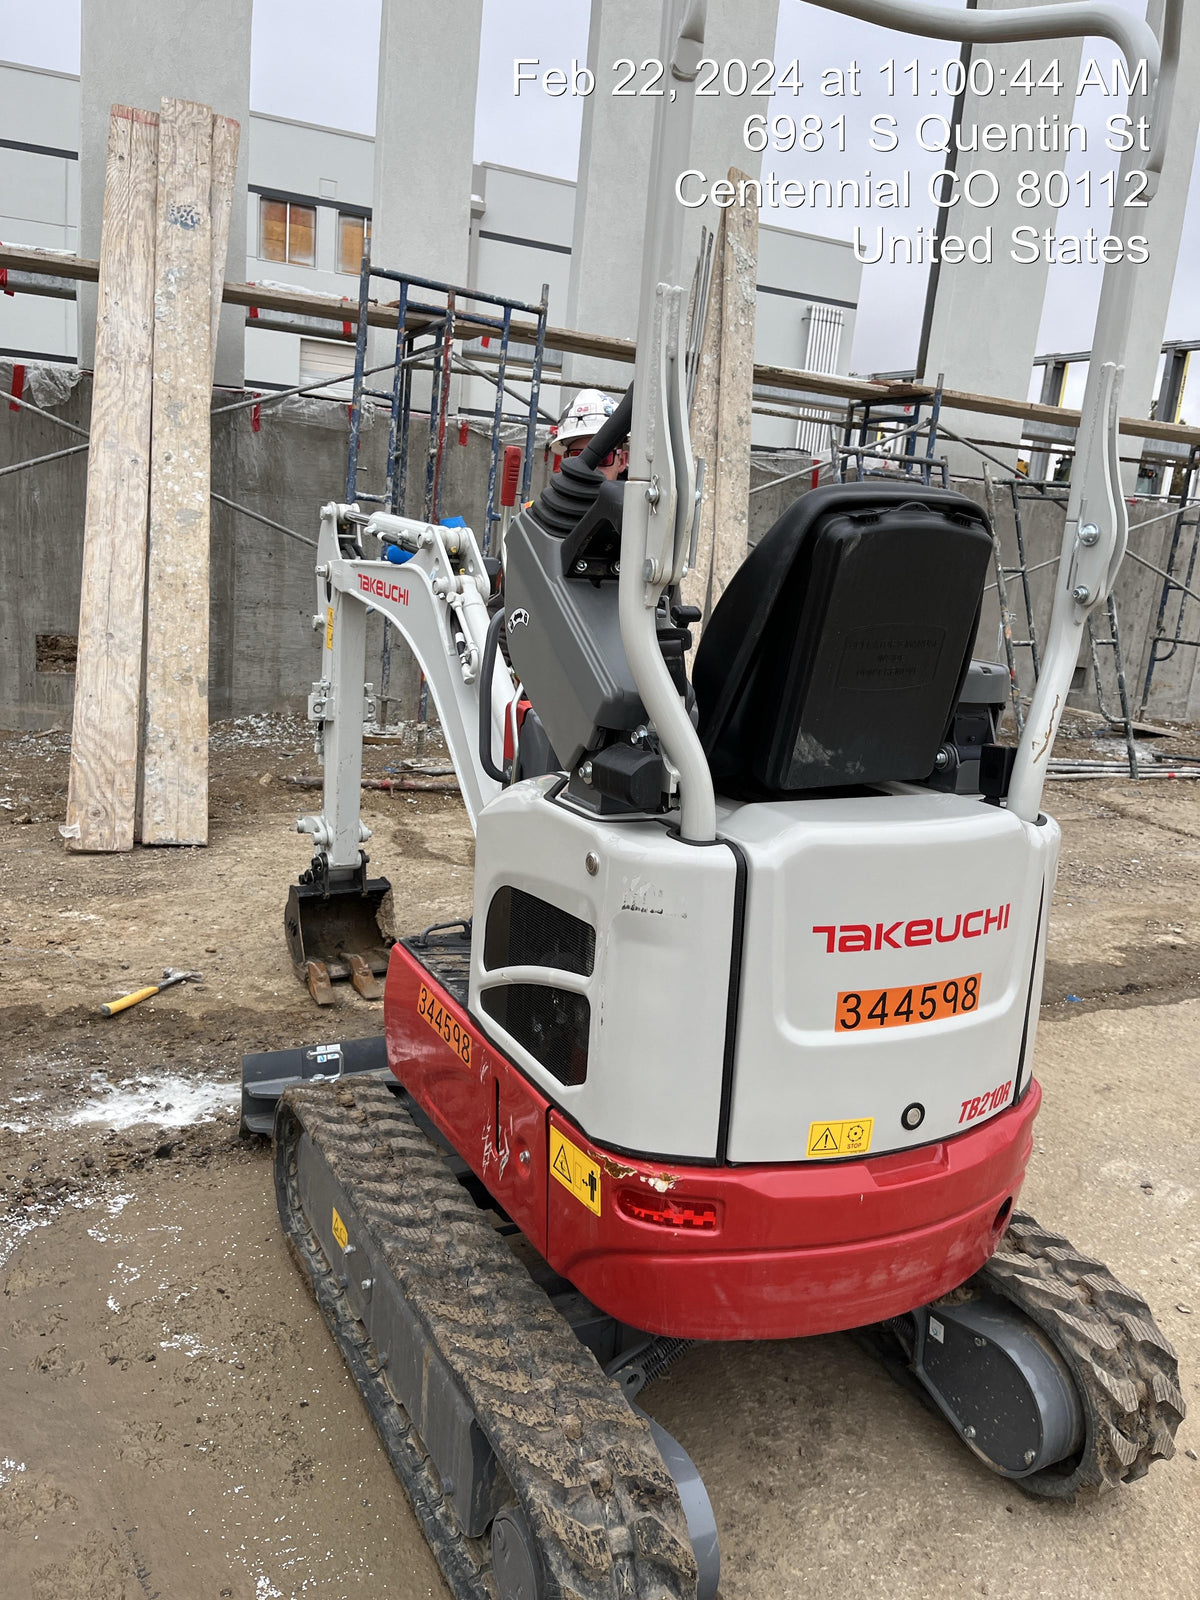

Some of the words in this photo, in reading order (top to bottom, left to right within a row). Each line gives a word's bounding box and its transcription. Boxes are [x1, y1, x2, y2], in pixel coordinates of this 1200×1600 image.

[357, 573, 409, 606] TAKEUCHI
[812, 903, 1011, 953] TAKEUCHI
[418, 987, 471, 1064] 344598
[840, 976, 978, 1030] 344598
[958, 1080, 1012, 1124] TB210R
[846, 1142, 862, 1150] STOP
